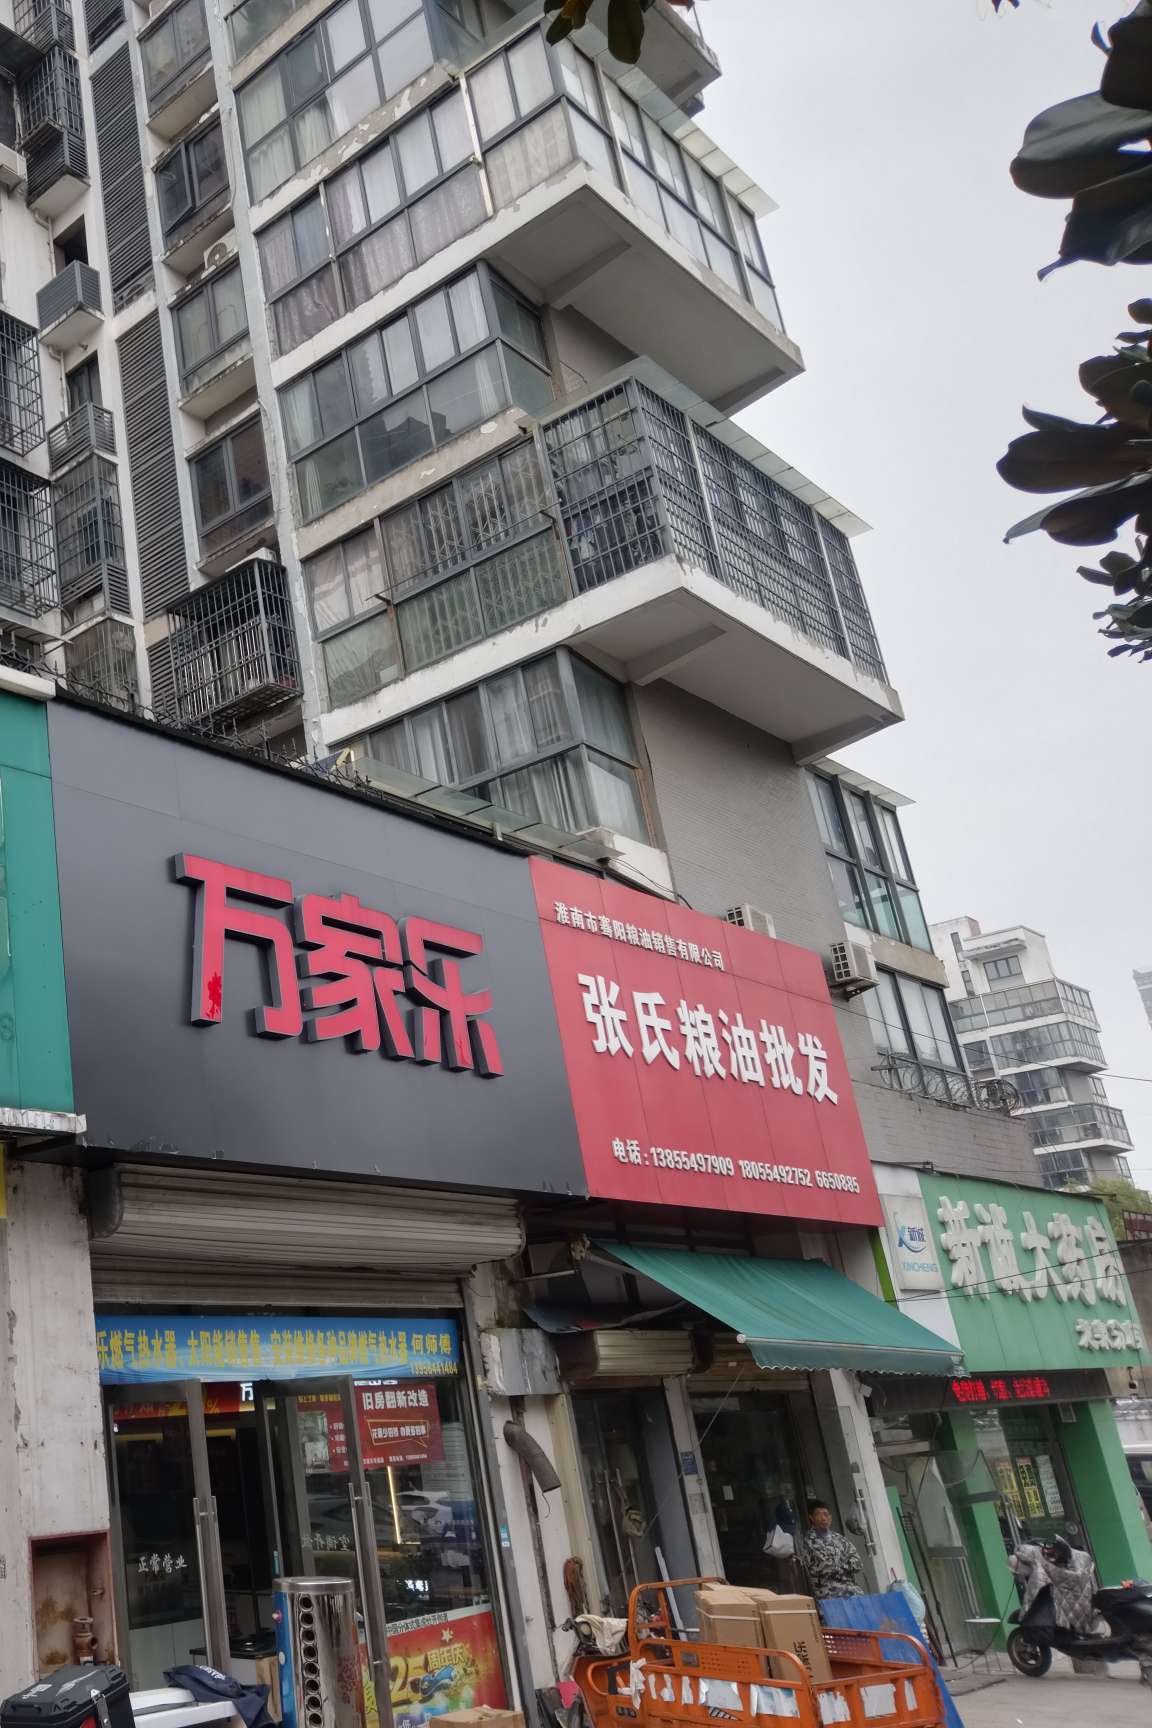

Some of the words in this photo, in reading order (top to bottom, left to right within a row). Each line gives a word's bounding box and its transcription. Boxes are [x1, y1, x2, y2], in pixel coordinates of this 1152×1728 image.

[172, 853, 504, 1079] 万家乐
[578, 973, 838, 1105] 张氏粮油批发
[363, 1389, 429, 1411] 旧房翻新改造
[138, 1553, 188, 1575] 正常营业
[427, 1642, 466, 1671] 周年庆
